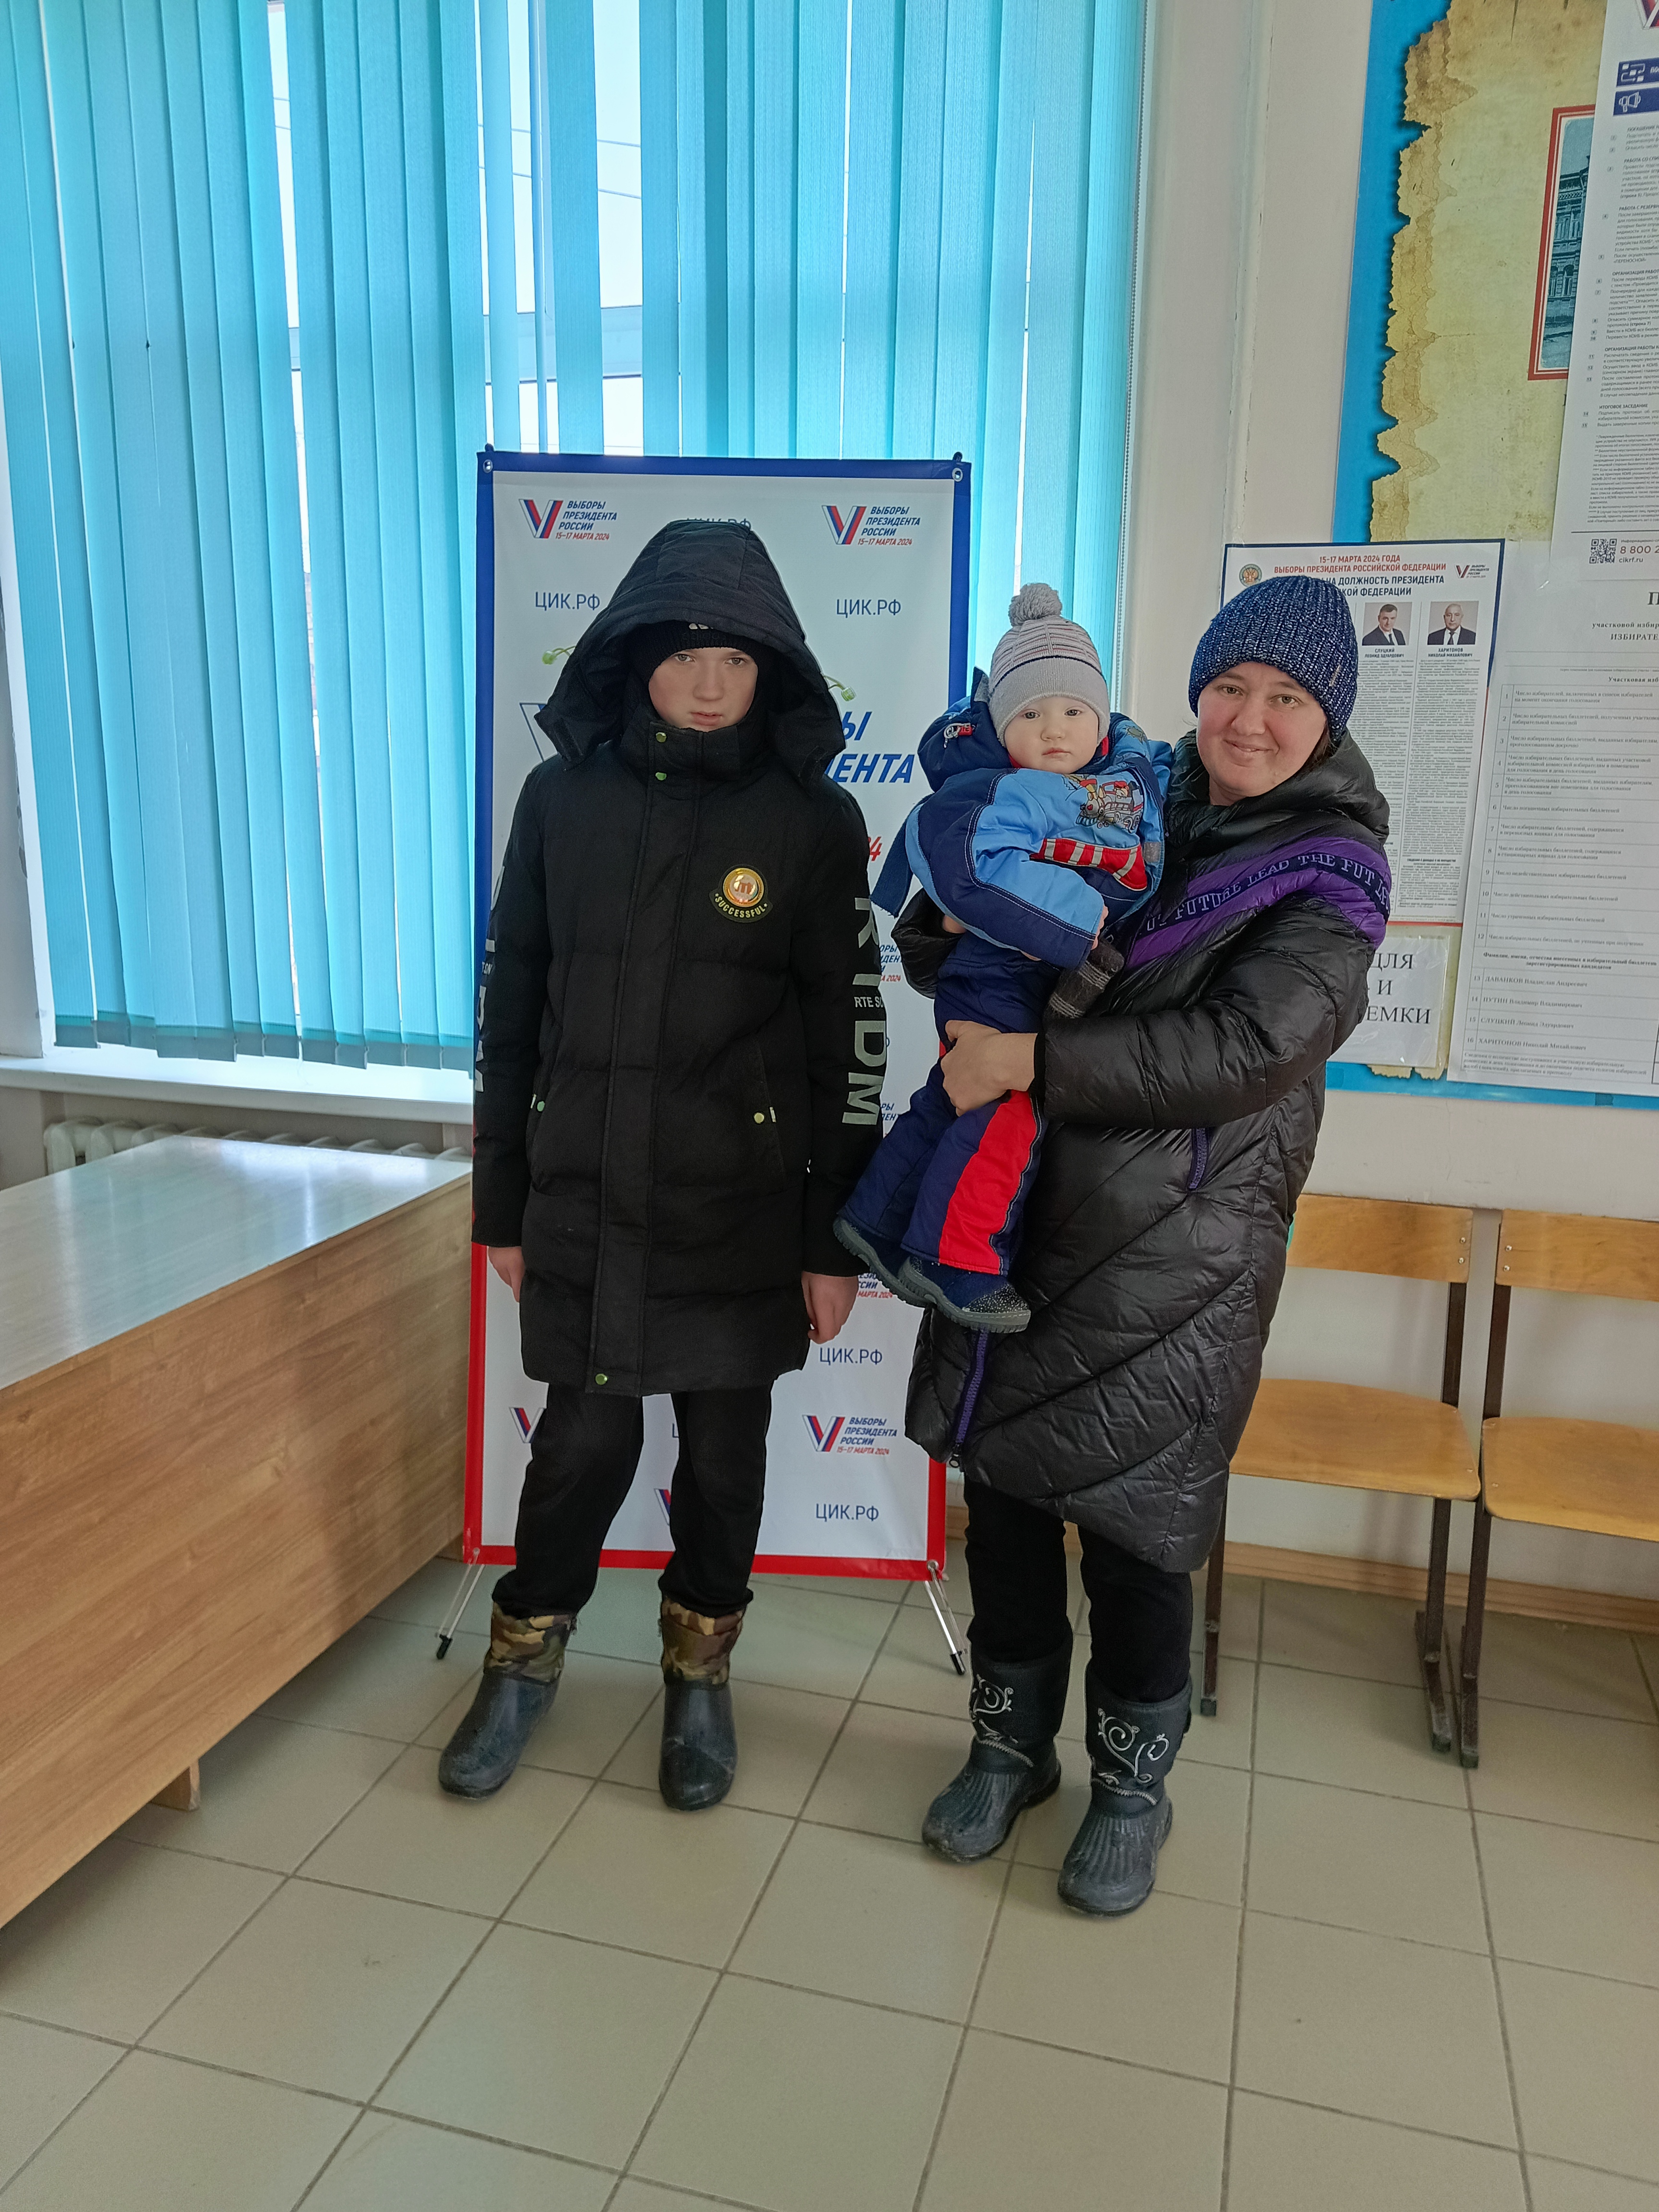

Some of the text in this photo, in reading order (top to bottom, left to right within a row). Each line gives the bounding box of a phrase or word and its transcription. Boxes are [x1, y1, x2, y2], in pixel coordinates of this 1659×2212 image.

[567, 501, 606, 509] ВЫБОРЫ
[563, 511, 617, 521] ПРЕЗИДЕНТА
[558, 522, 594, 530] РОССИИ
[866, 517, 920, 526] ПРЕЗИДЕНТА
[1307, 565, 1351, 573] ПРЕЗИДЕНТА
[1353, 563, 1400, 572] РОССИЙСКОЙ
[1402, 563, 1446, 572] ФЕДЕРАЦИИ
[1338, 576, 1389, 586] ДОЛЖНОСТЬ
[1392, 576, 1444, 585] ПРЕЗИДЕНТА
[1360, 587, 1411, 597] ФЕДЕРАЦИИ
[535, 591, 600, 611] ЦИК.РФ
[837, 599, 901, 618] ЦИК.РФ
[825, 754, 915, 783] ЕНТА
[1247, 860, 1289, 887] LEAD
[1298, 854, 1335, 867] THE
[1175, 882, 1241, 920] FUTURE
[715, 896, 766, 918] SUCCESSFUL
[1377, 979, 1393, 996] И
[1367, 1005, 1432, 1024] ЕМКИ
[1479, 1038, 1521, 1047] ХАРИТОНОВ
[820, 1347, 883, 1366] ЦИК.РФ
[849, 1417, 887, 1426] ВЫБОРЫ
[844, 1427, 898, 1437] ПРЕЗИДЕНТА
[840, 1437, 875, 1445] РОССИИ
[816, 1503, 879, 1522] ЦИК.РФ
